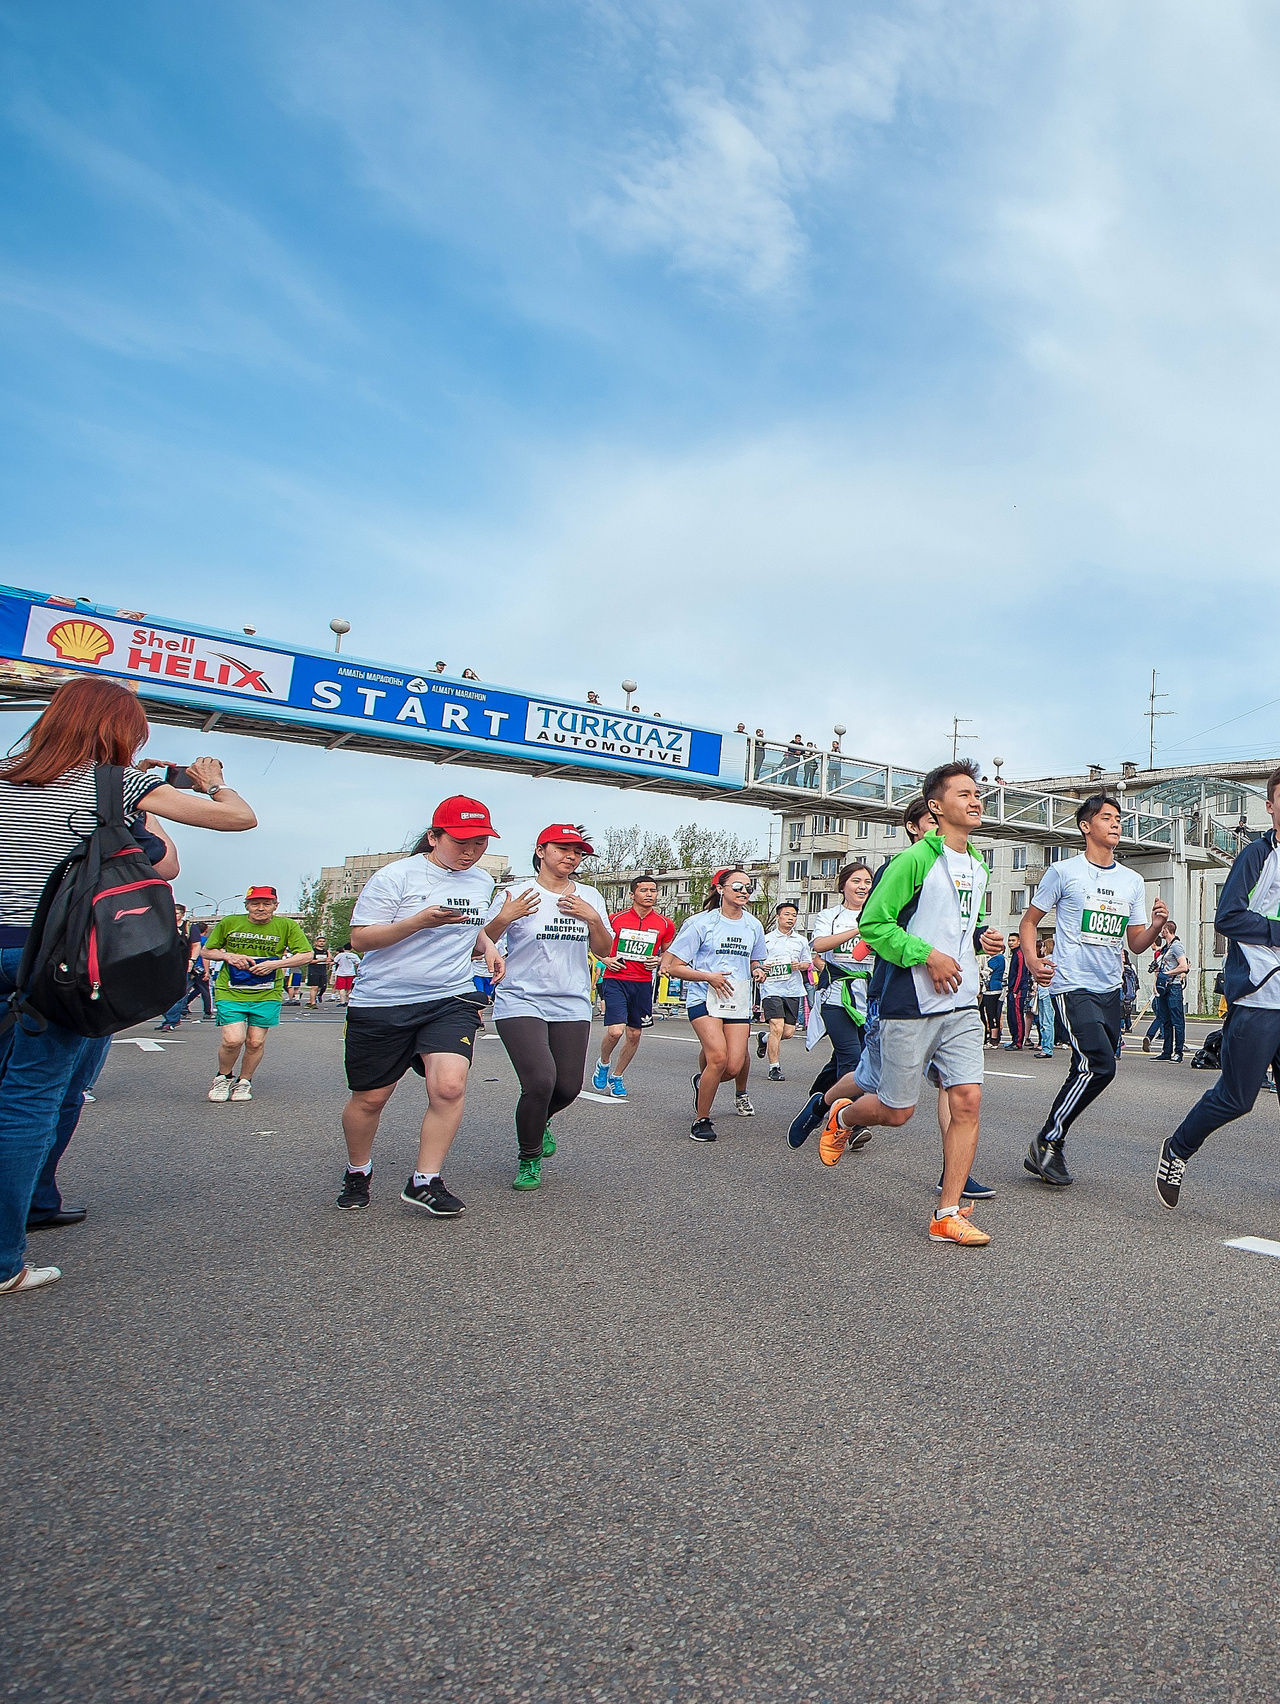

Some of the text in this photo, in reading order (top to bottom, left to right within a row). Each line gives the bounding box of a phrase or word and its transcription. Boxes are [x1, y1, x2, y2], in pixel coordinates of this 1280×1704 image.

[131, 629, 196, 655] Shell
[127, 647, 273, 694] HELIX
[337, 667, 404, 686] АЛМАТЫ МАРАФОНЫ
[431, 684, 487, 702] ALMATY MARATHON
[311, 680, 510, 737] START
[537, 706, 683, 752] TURKUAZ
[536, 731, 682, 764] AUTOMOTIVE
[454, 898, 470, 906] БЕГУ
[544, 924, 585, 934] НАВСТРЕЧУ
[560, 917, 576, 925] БЕГУ
[1089, 911, 1123, 935] 08304
[536, 932, 560, 941] СВОЕЙ
[624, 940, 649, 955] 11457
